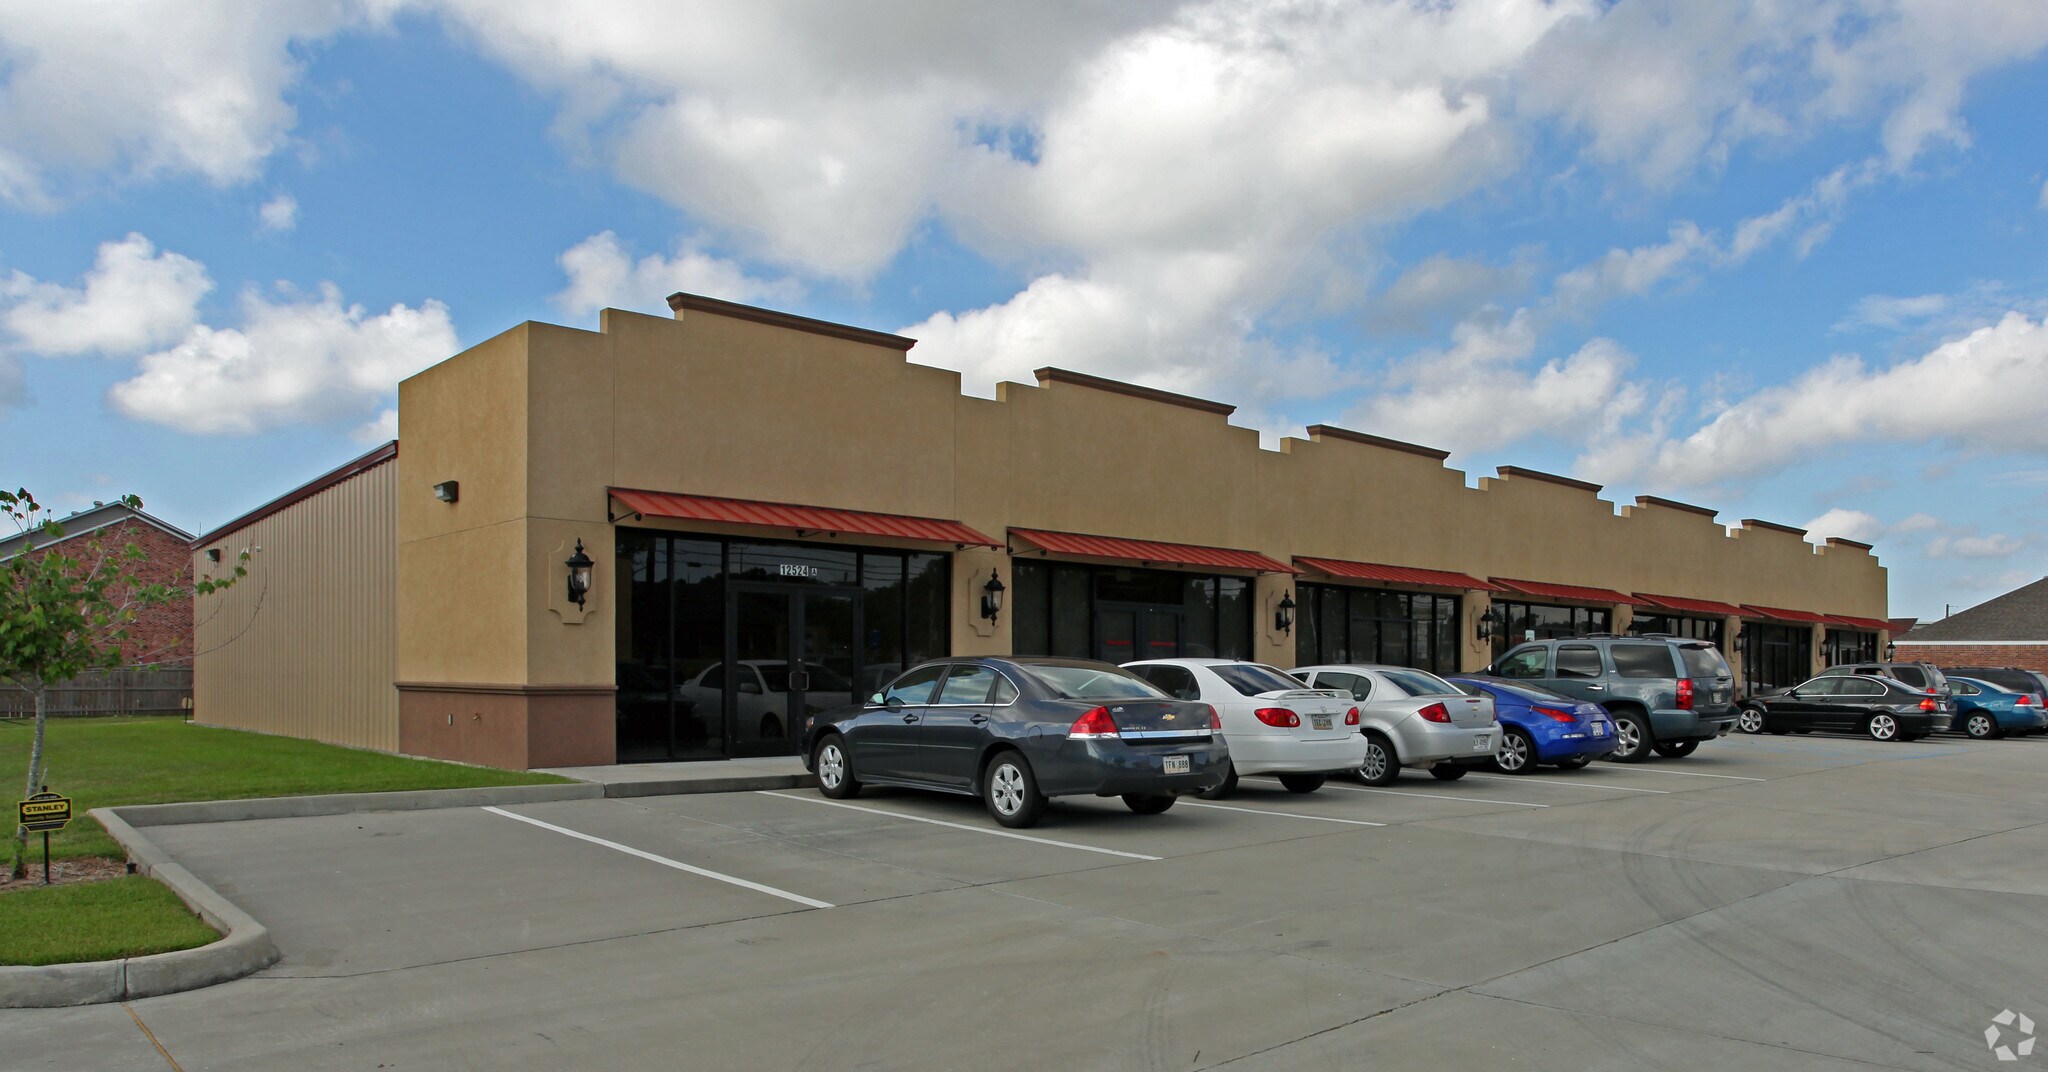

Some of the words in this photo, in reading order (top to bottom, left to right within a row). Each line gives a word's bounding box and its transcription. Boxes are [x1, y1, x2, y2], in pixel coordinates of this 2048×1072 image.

[780, 565, 808, 576] 12524
[811, 567, 817, 576] A
[26, 803, 65, 813] STANLEY
